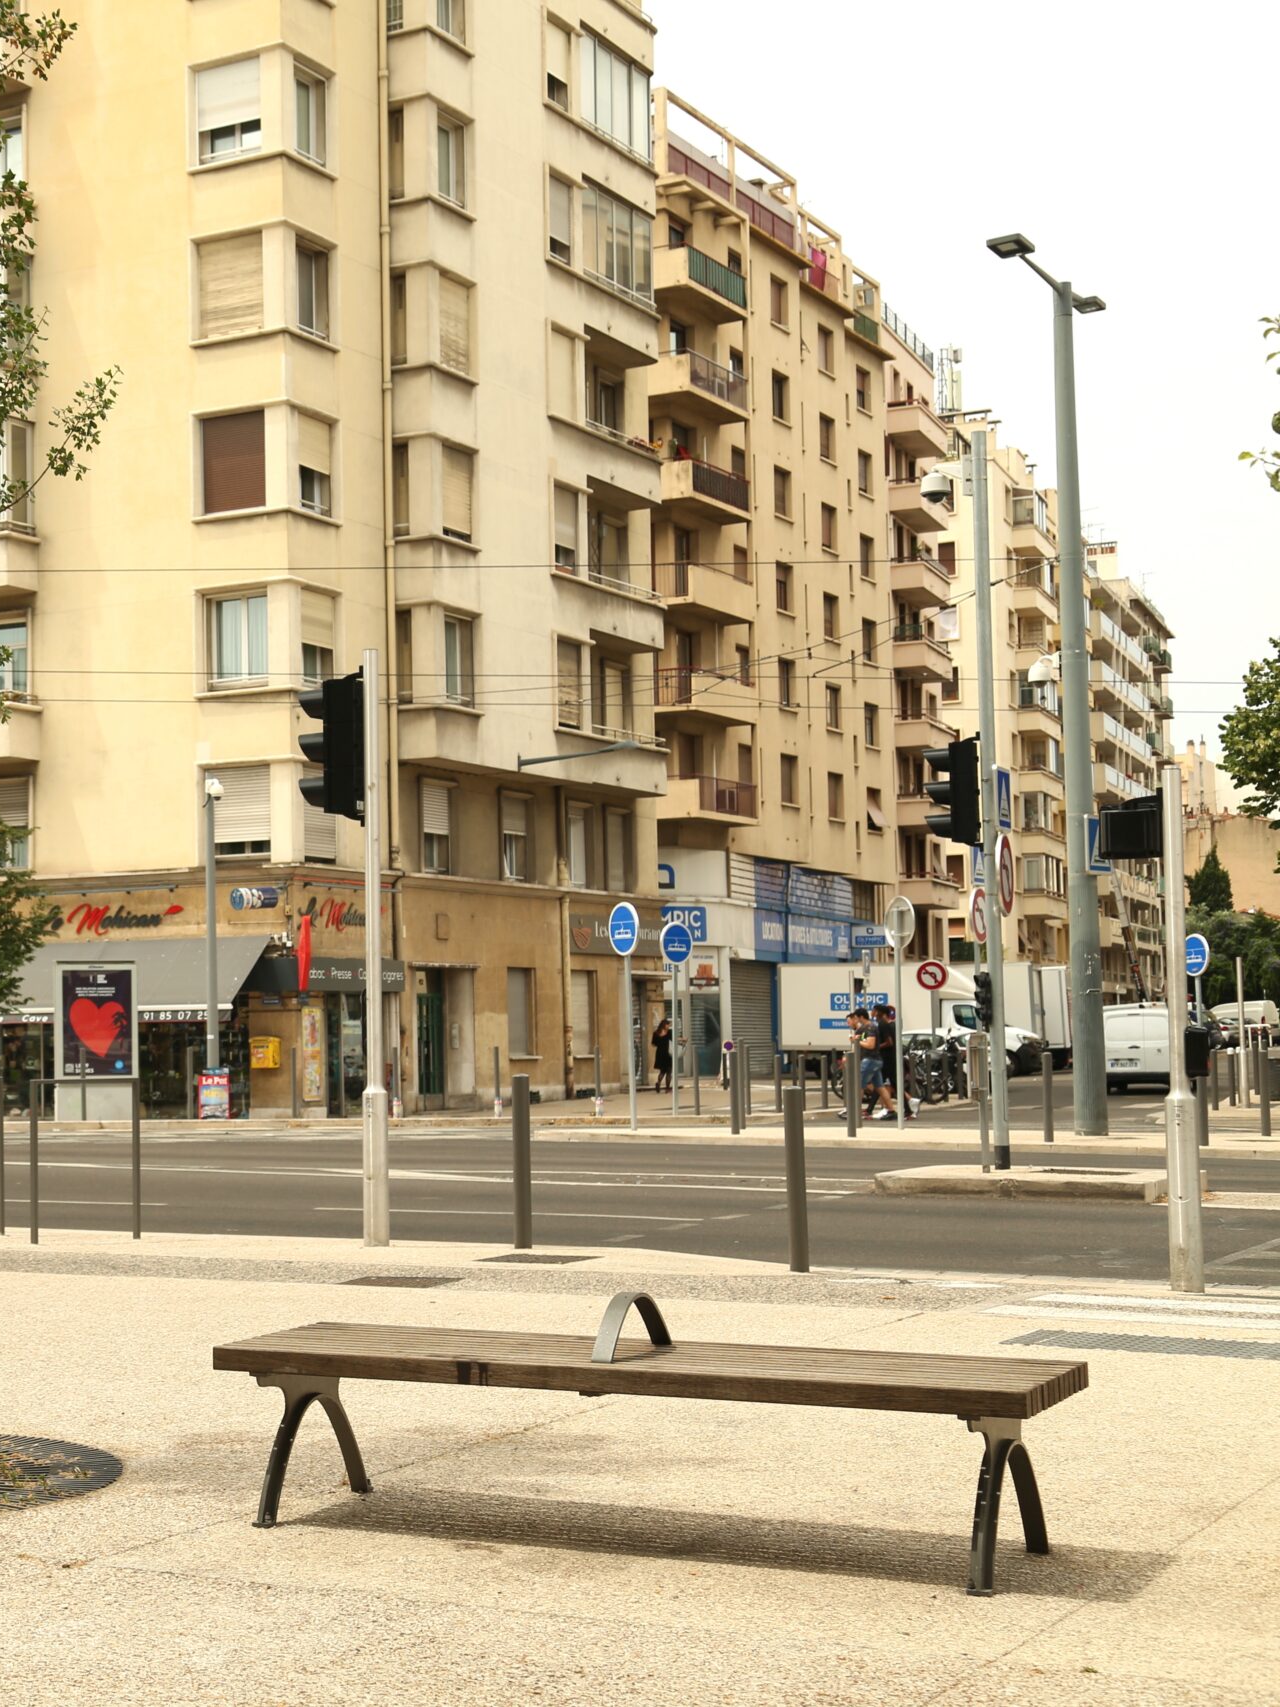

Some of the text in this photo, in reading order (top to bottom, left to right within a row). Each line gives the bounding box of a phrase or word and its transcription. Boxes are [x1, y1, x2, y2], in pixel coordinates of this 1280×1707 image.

[67, 903, 163, 936] Mohican
[331, 967, 352, 981] Presse
[21, 1014, 49, 1023] Cave
[143, 1012, 154, 1021] 91
[159, 1011, 173, 1021] 85
[177, 1011, 192, 1020] 07
[202, 1076, 213, 1086] Le
